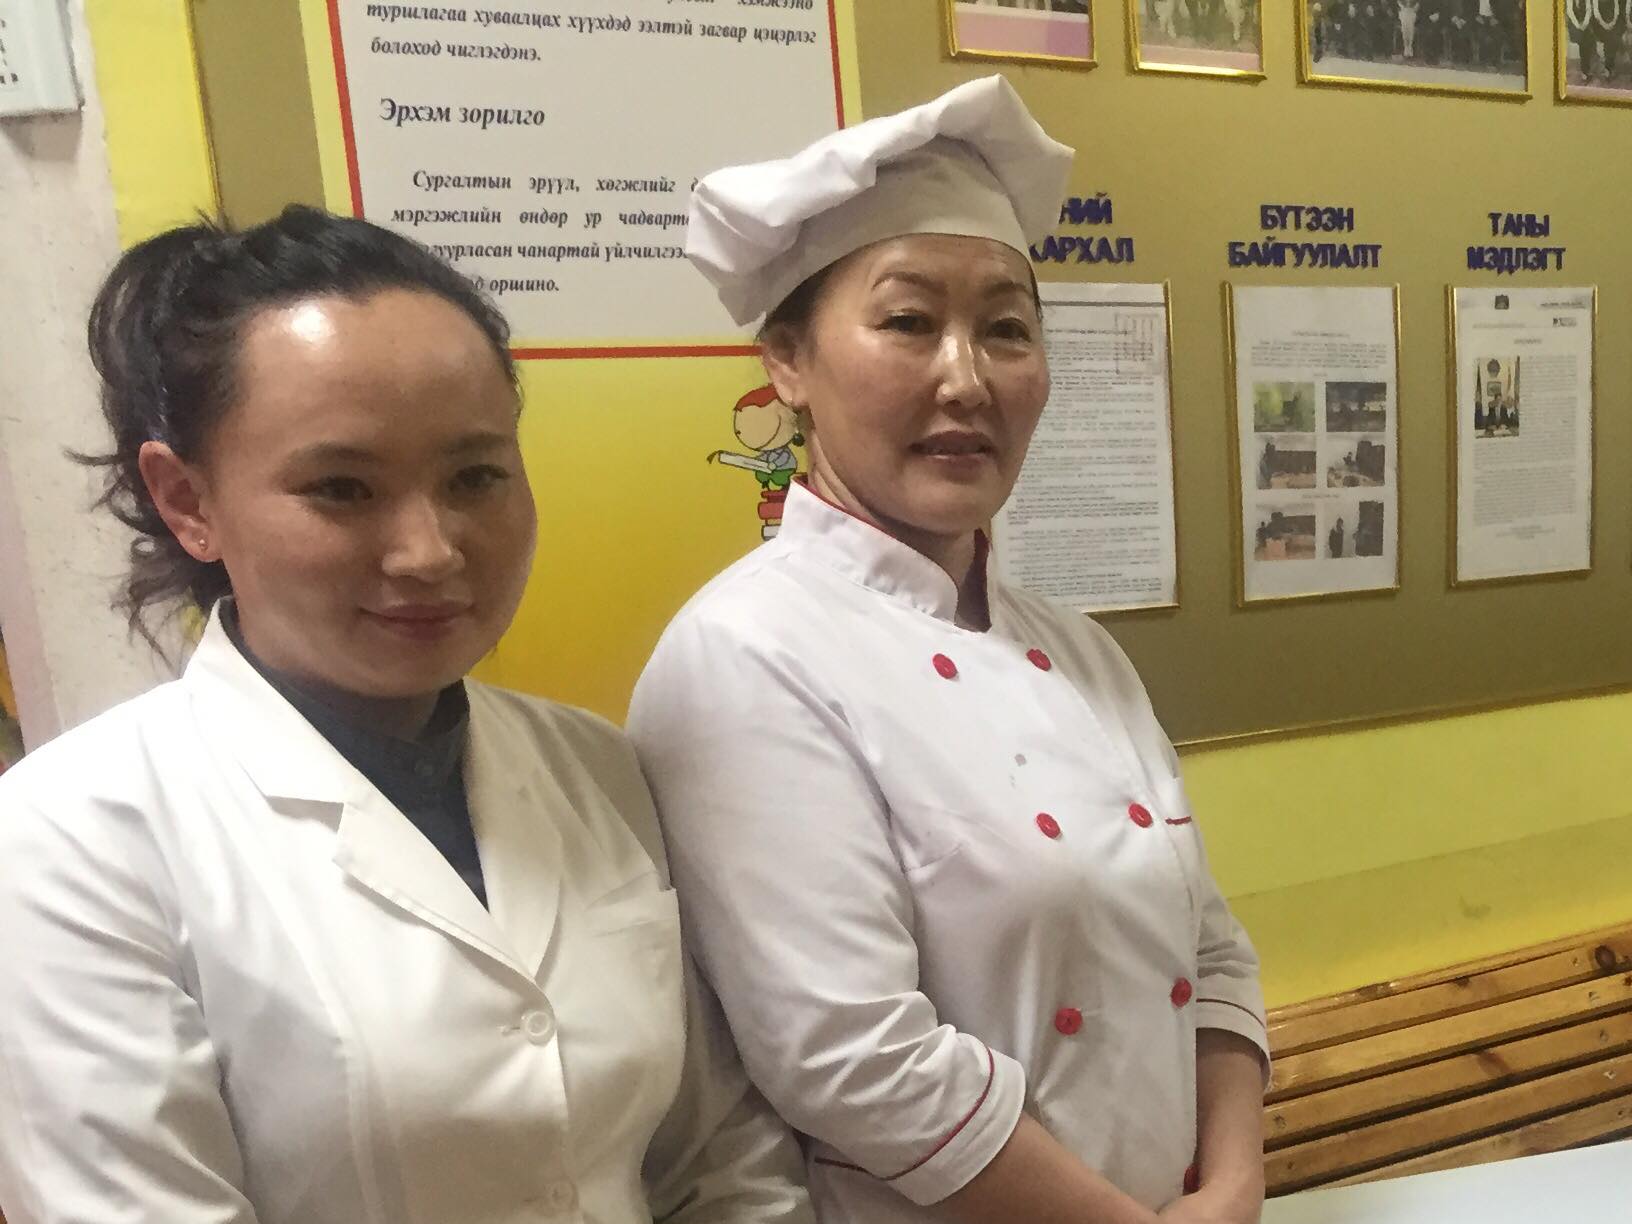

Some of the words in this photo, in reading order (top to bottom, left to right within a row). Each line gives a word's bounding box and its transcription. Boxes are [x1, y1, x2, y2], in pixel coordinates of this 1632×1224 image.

[366, 4, 467, 24] туршлагаа
[473, 9, 562, 30] хуваалцах
[567, 14, 632, 34] хүүхдэд
[638, 18, 693, 36] ээлтэй
[699, 23, 748, 43] загвар
[753, 27, 817, 47] цэцэрлэг
[370, 36, 442, 57] болоход
[446, 42, 542, 62] чиглэгдэнэ.
[379, 97, 452, 128] Эрхэм
[458, 107, 546, 131] зорилго
[412, 170, 512, 193] Сургалтын
[595, 175, 676, 193] хөгжлийг
[390, 206, 502, 228] мэргэжлийн
[519, 207, 569, 229] өндөр
[583, 212, 602, 229] ур
[1488, 212, 1550, 237] ТАНЫ
[423, 244, 513, 262] уурласан
[517, 241, 600, 263] чанартай
[604, 241, 688, 262] үйлчилгээ
[1466, 246, 1566, 275] МЭДЛЭГТ
[487, 279, 560, 298] оршино.
